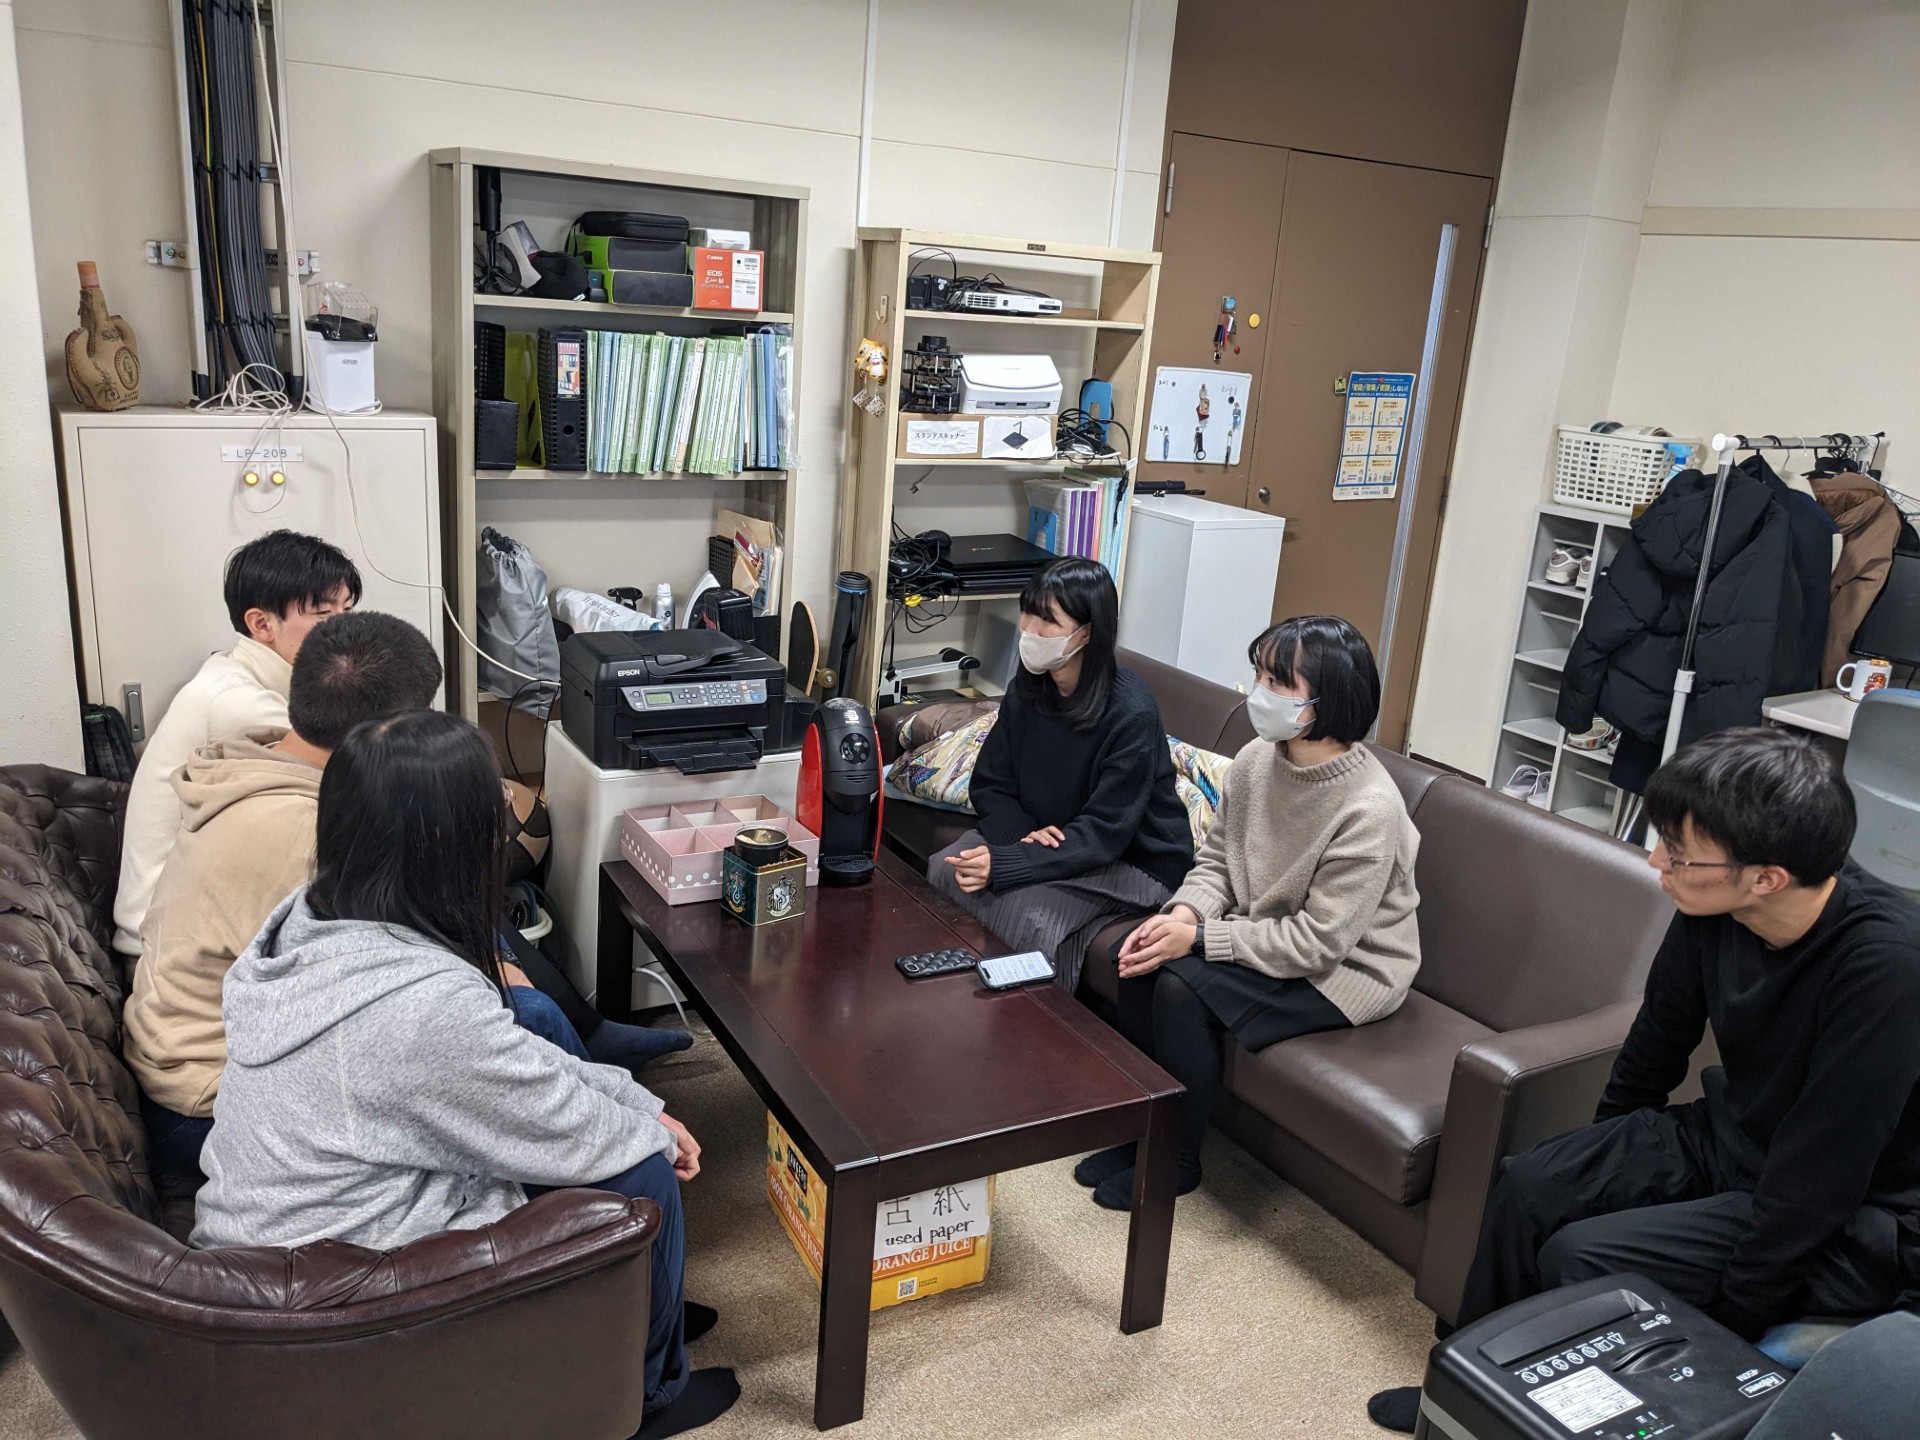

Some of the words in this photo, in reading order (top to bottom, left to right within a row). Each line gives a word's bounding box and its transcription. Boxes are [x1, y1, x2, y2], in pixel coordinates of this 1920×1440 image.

[706, 269, 723, 277] EOS
[914, 432, 966, 440] スタンドスキャナー
[236, 448, 288, 459] LP-208
[617, 668, 641, 677] EPSON
[783, 1195, 808, 1244] ORANGE
[884, 1226, 923, 1246] used
[929, 1219, 976, 1244] paper
[931, 1237, 971, 1261] JUICE
